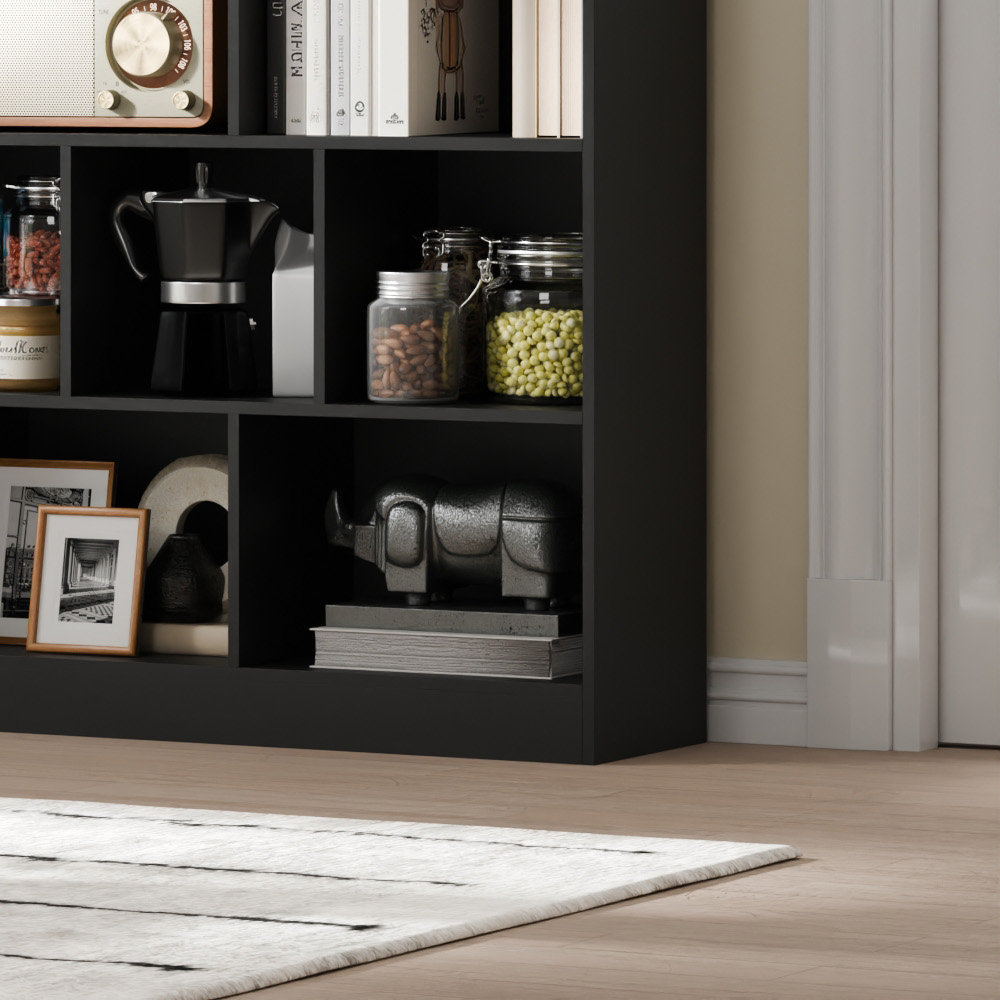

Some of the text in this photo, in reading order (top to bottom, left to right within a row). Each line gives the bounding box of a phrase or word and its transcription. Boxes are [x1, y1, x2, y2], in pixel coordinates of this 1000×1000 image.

[149, 2, 158, 12] 98
[177, 19, 189, 33] 103
[183, 39, 192, 51] 106
